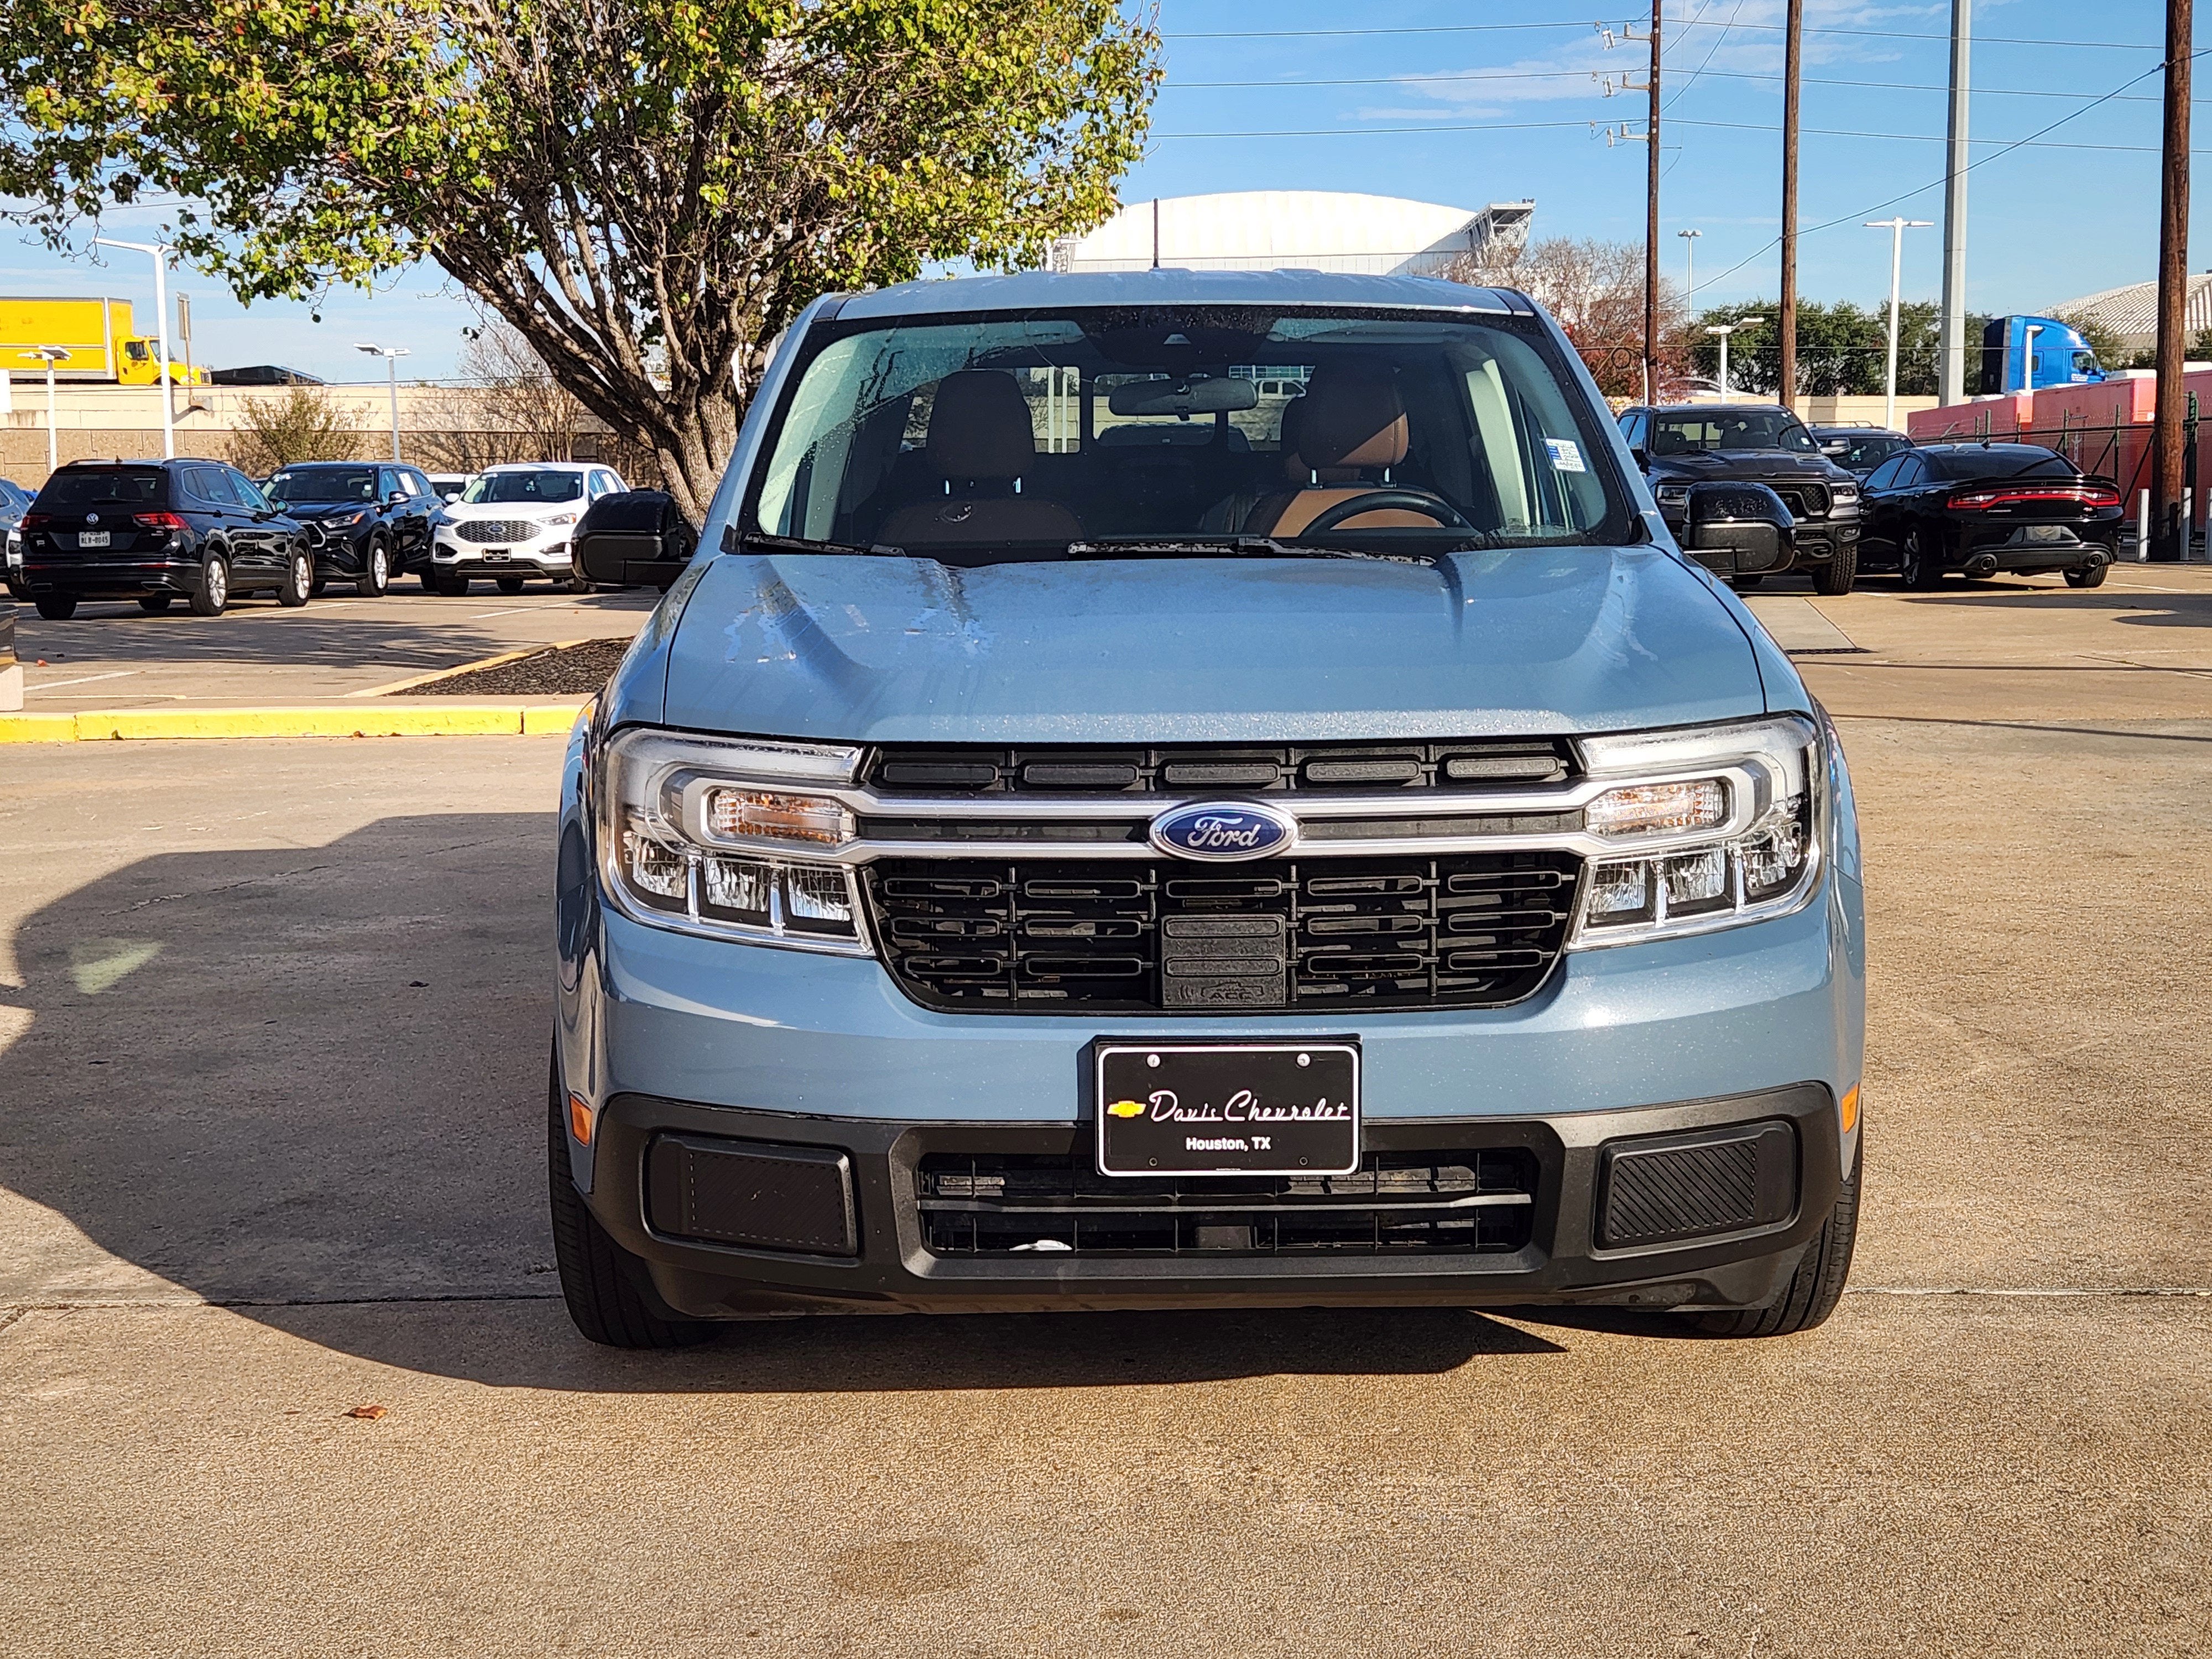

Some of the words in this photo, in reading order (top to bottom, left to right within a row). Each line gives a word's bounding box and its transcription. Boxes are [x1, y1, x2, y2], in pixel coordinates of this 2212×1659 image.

[1187, 816, 1261, 847] Ford
[1149, 1090, 1224, 1122] Davis
[1224, 1089, 1352, 1121] Chevrolet
[1186, 1137, 1249, 1152] Houston,
[1251, 1136, 1271, 1150] TX
